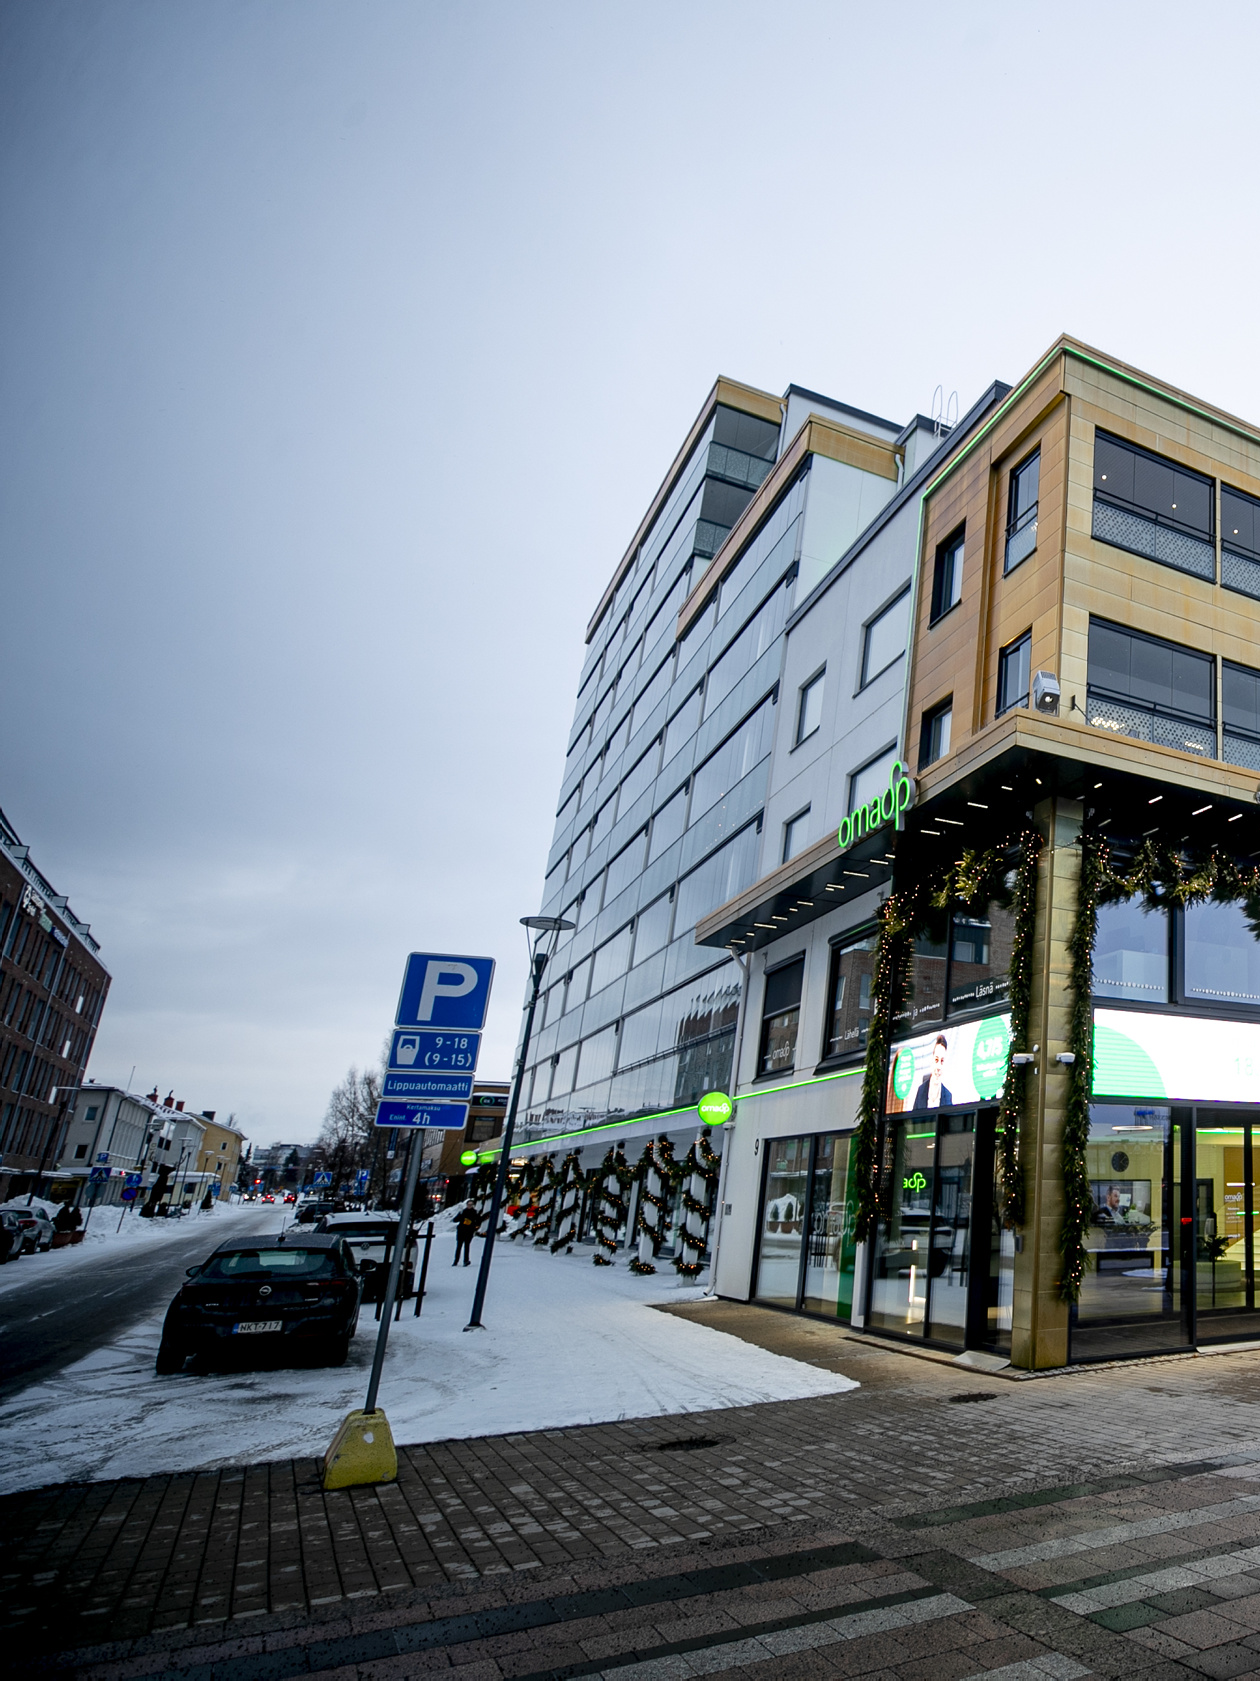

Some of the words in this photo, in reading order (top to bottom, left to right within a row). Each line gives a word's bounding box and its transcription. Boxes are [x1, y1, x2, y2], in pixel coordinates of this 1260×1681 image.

[417, 960, 478, 1021] P
[387, 1080, 469, 1092] Lippuautomaatti
[406, 1104, 441, 1112] Kertamaksu
[412, 1112, 431, 1125] 4h
[754, 1138, 760, 1156] 9
[240, 1321, 281, 1333] NKT-717
